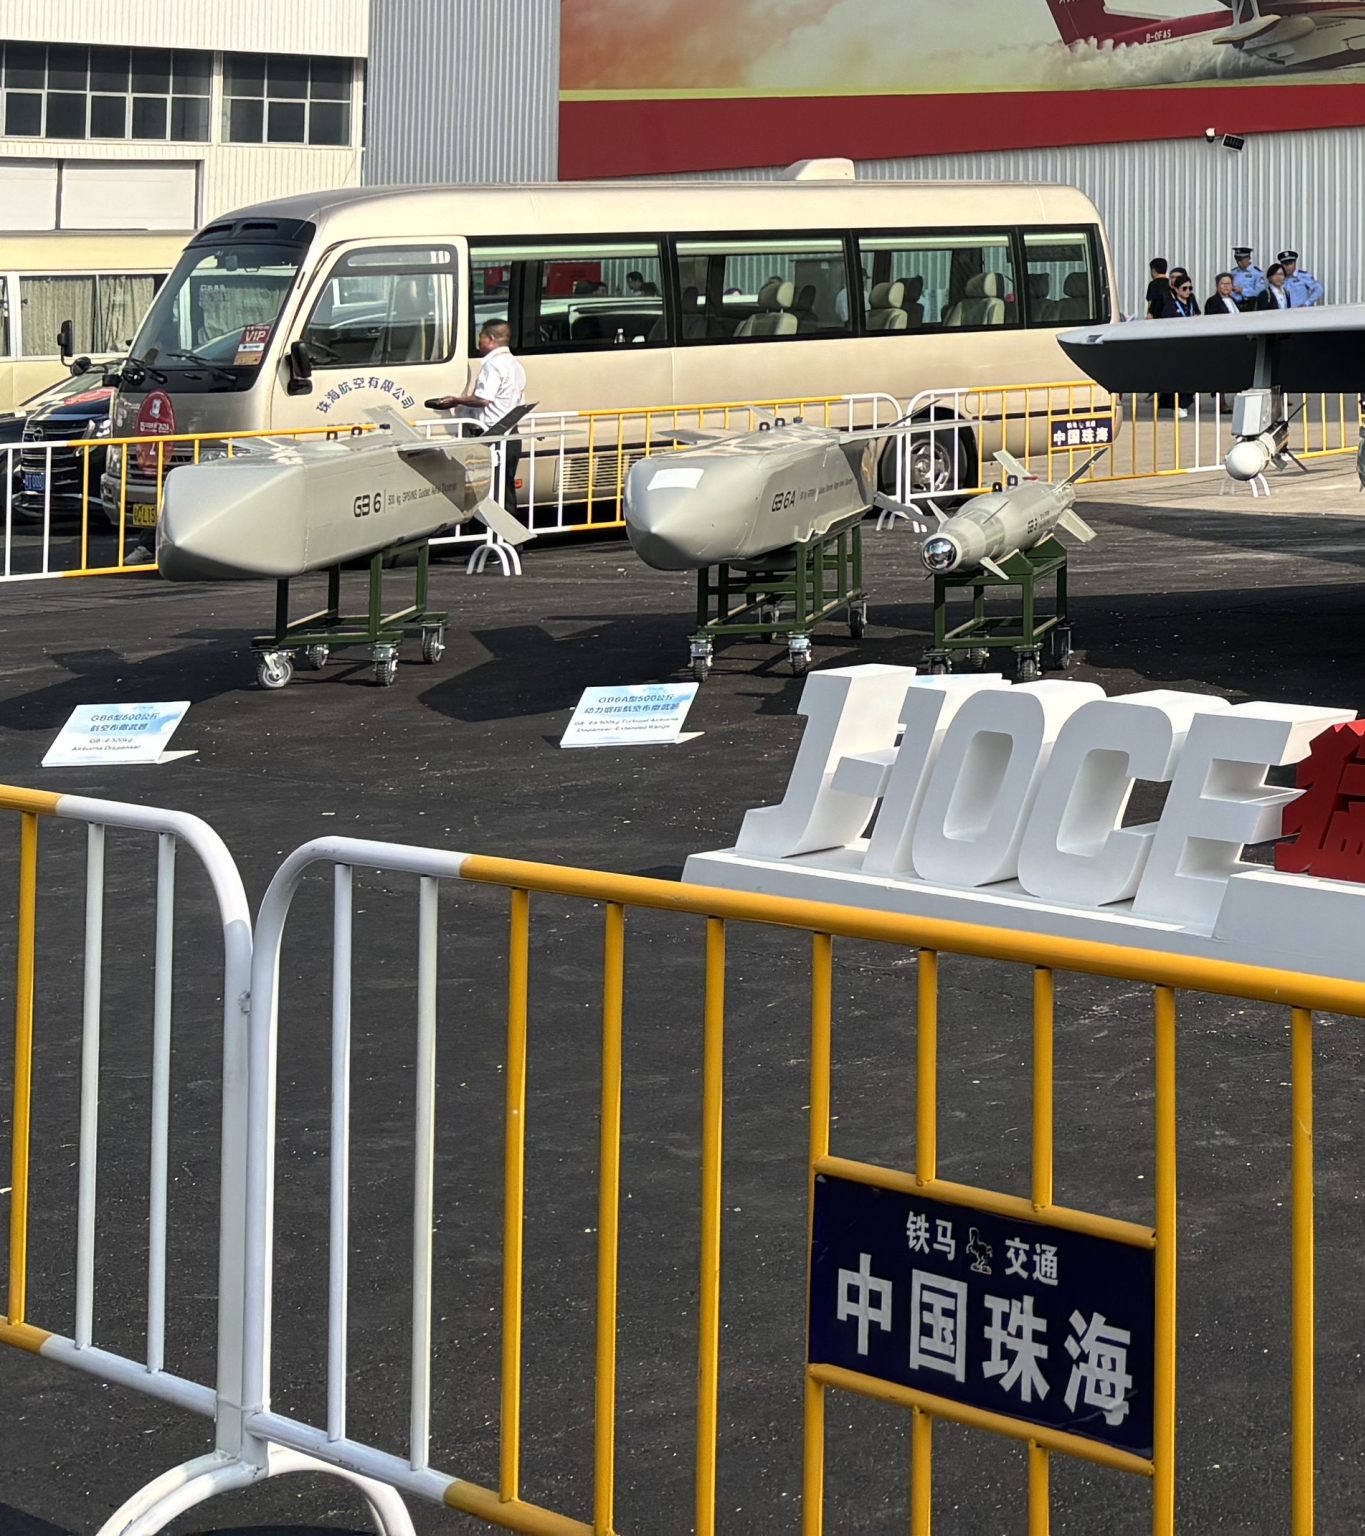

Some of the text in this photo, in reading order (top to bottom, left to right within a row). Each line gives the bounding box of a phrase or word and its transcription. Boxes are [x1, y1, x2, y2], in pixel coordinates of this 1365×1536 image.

[245, 330, 266, 342] VIP
[316, 376, 415, 413] 珠海航空有限公司
[1053, 427, 1109, 446] 中国珠海
[905, 1211, 1059, 1286] 铁马 交通
[836, 1252, 1133, 1426] 中国珠海
